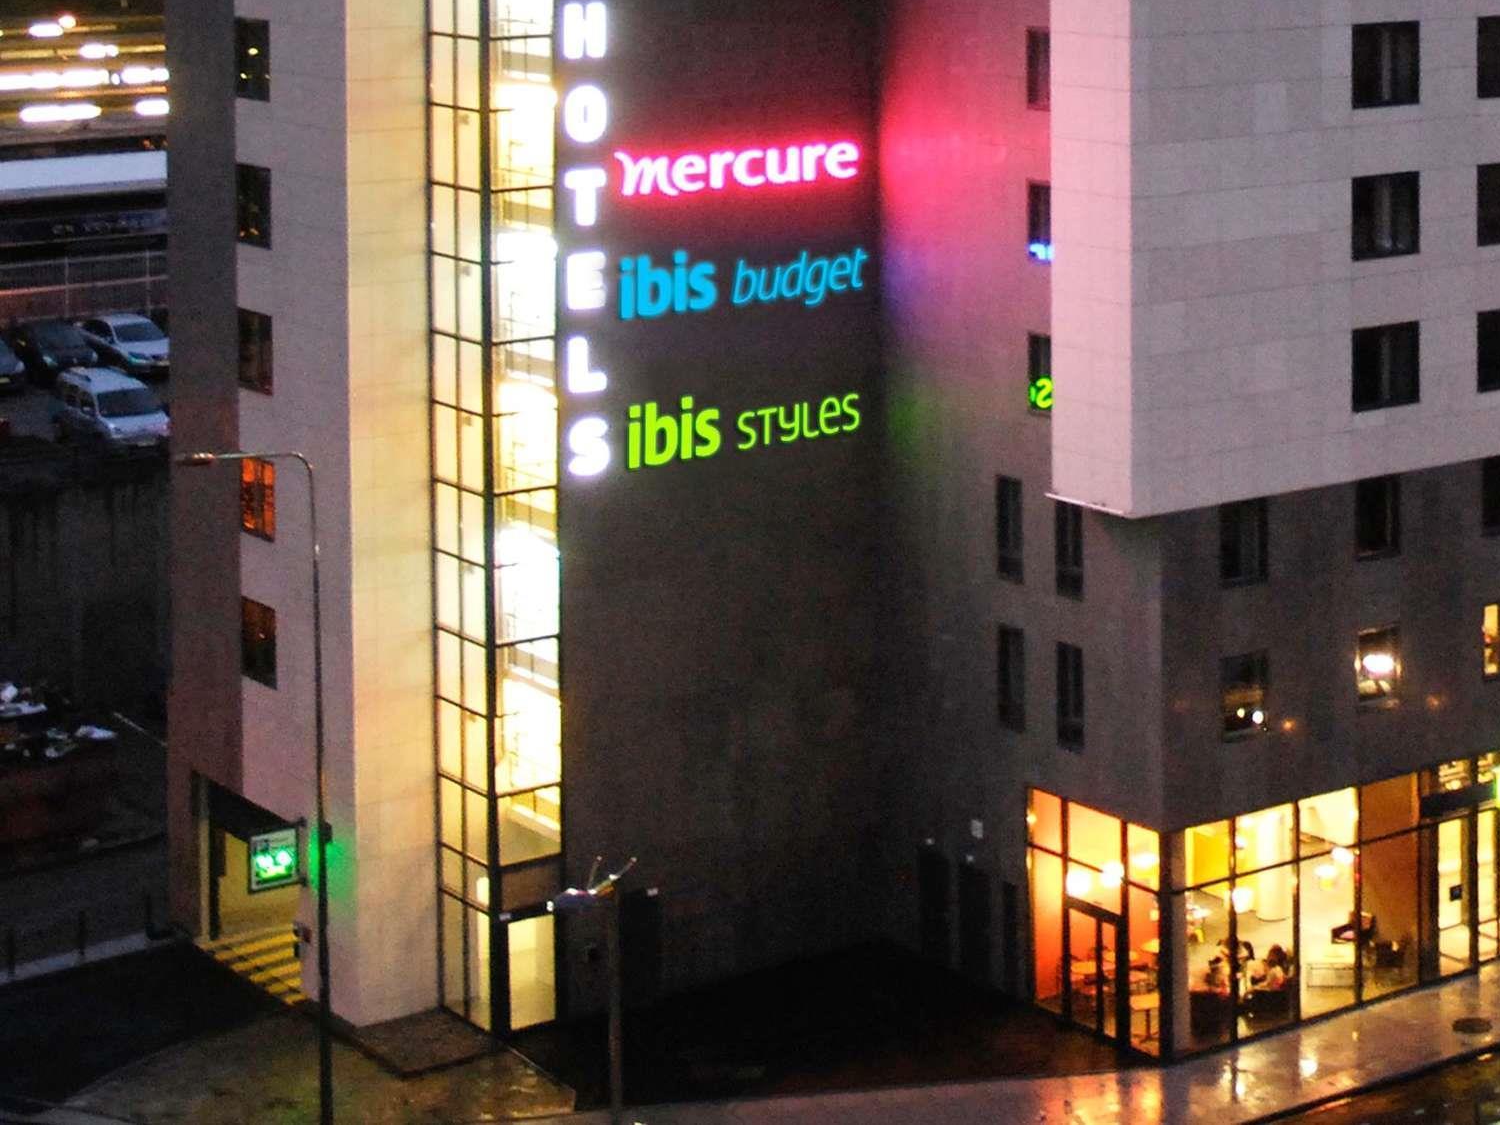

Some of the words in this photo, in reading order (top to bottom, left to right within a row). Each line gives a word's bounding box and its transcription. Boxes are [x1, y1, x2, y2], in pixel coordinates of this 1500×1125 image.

[614, 141, 860, 197] mercure
[562, 2, 611, 477] HOTELS
[619, 250, 717, 319] ibis
[732, 248, 867, 306] budget
[628, 395, 720, 468] ibis
